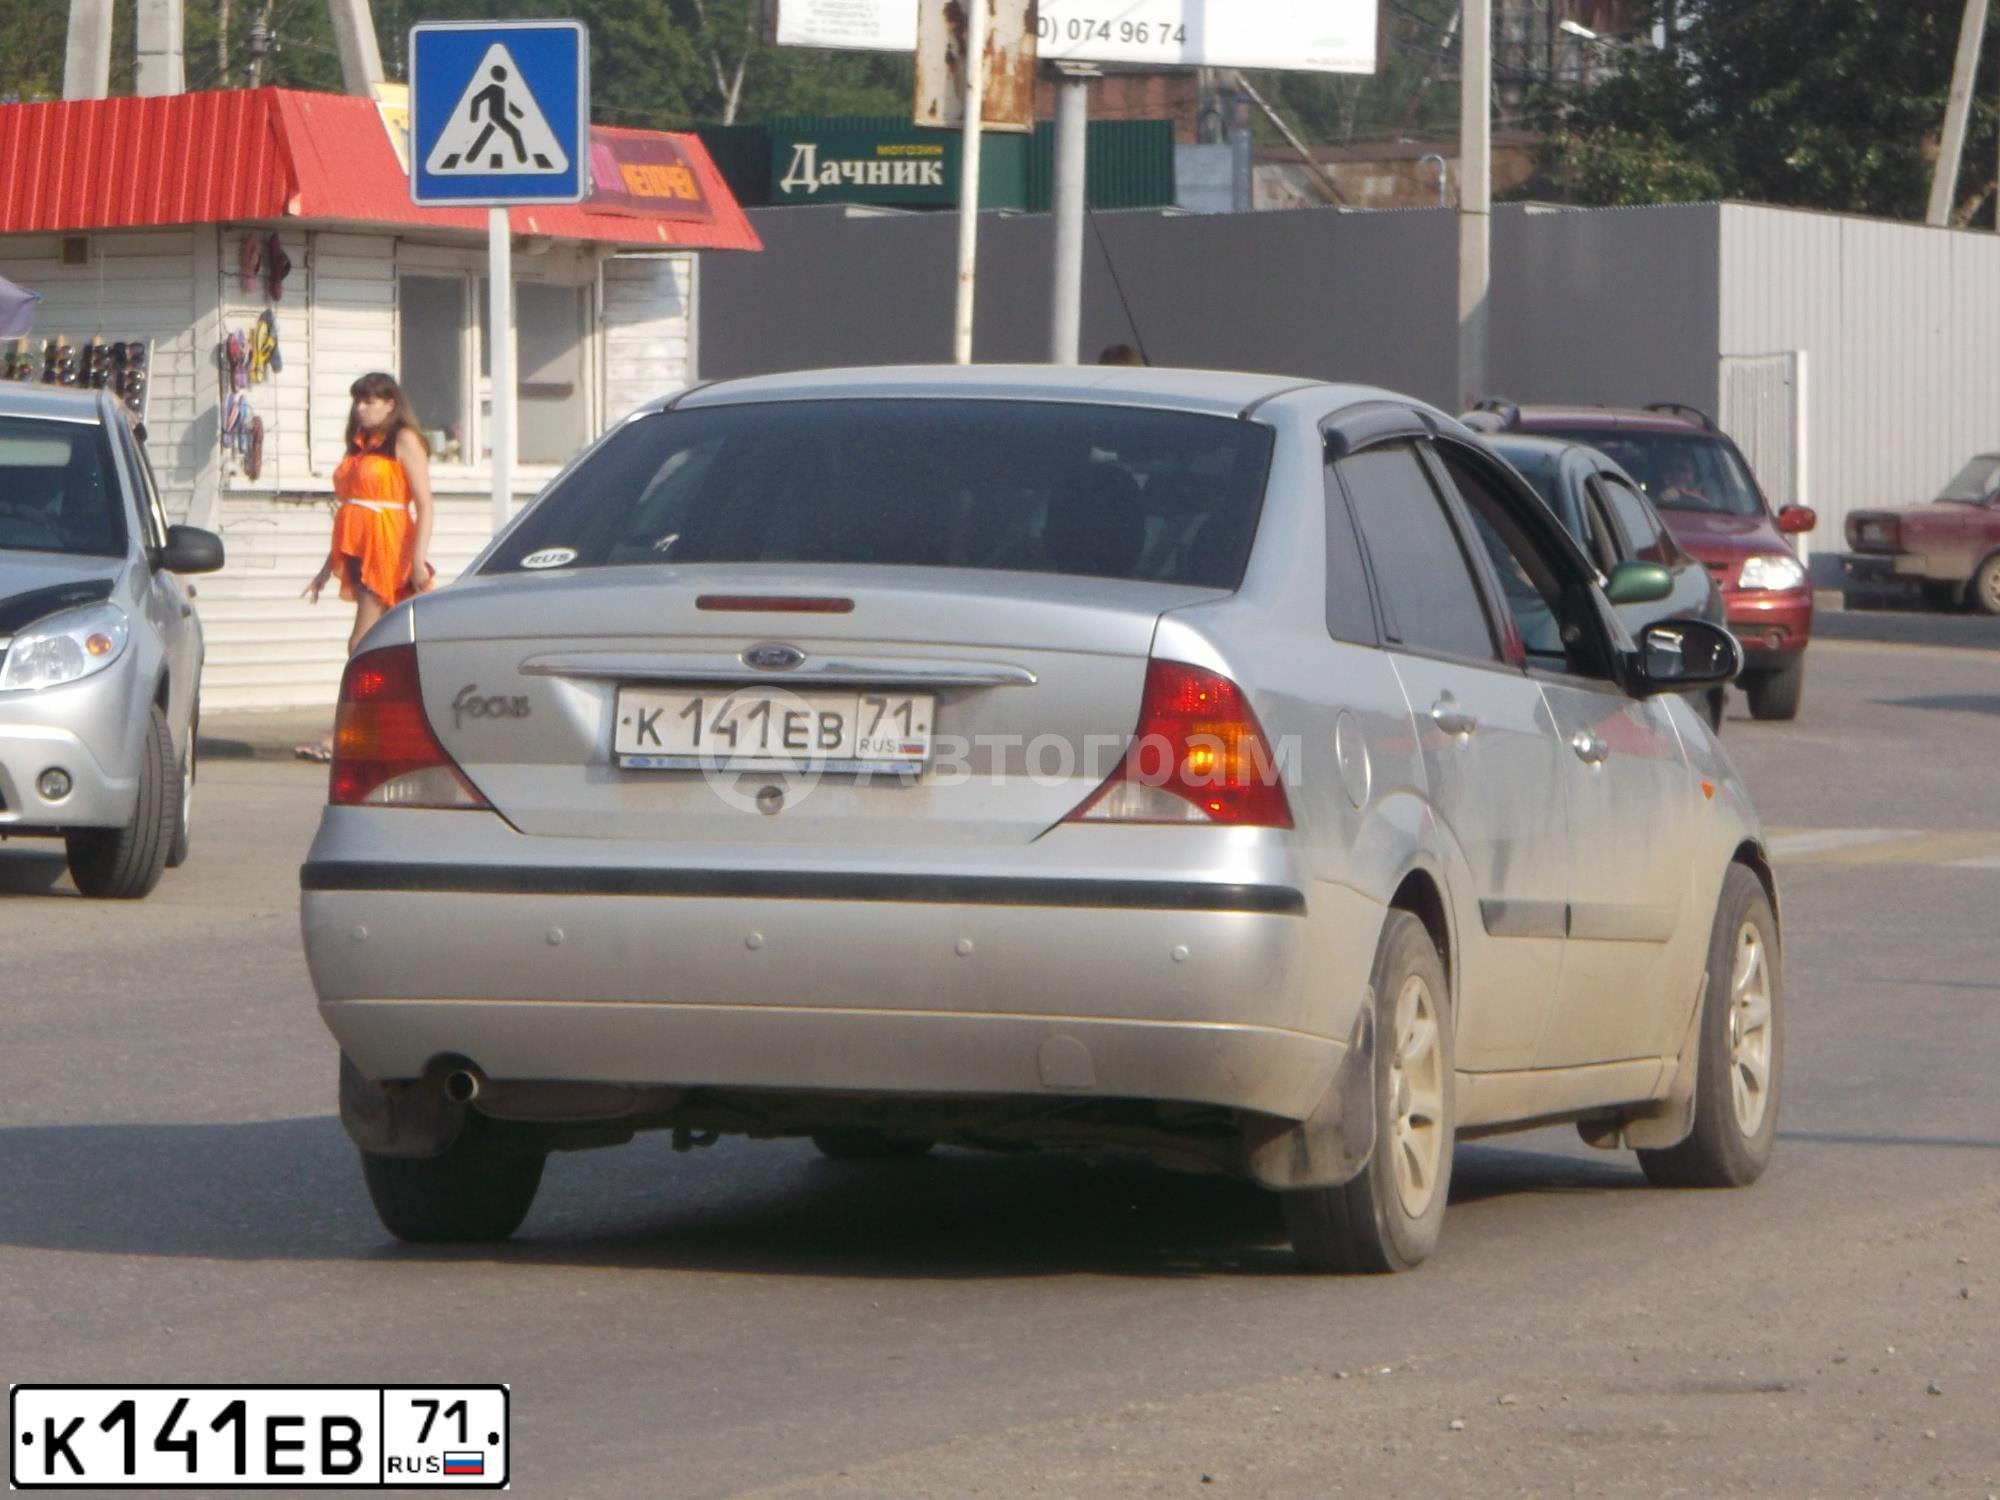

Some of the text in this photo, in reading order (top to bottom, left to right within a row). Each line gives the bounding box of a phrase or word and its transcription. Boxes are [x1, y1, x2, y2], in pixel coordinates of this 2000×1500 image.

[1067, 19, 1111, 42] 074
[1120, 22, 1149, 43] 96
[1159, 23, 1187, 45] 74
[780, 143, 944, 194] Дачник
[528, 551, 571, 565] RUS
[863, 699, 912, 737] 71
[859, 738, 896, 753] RUS
